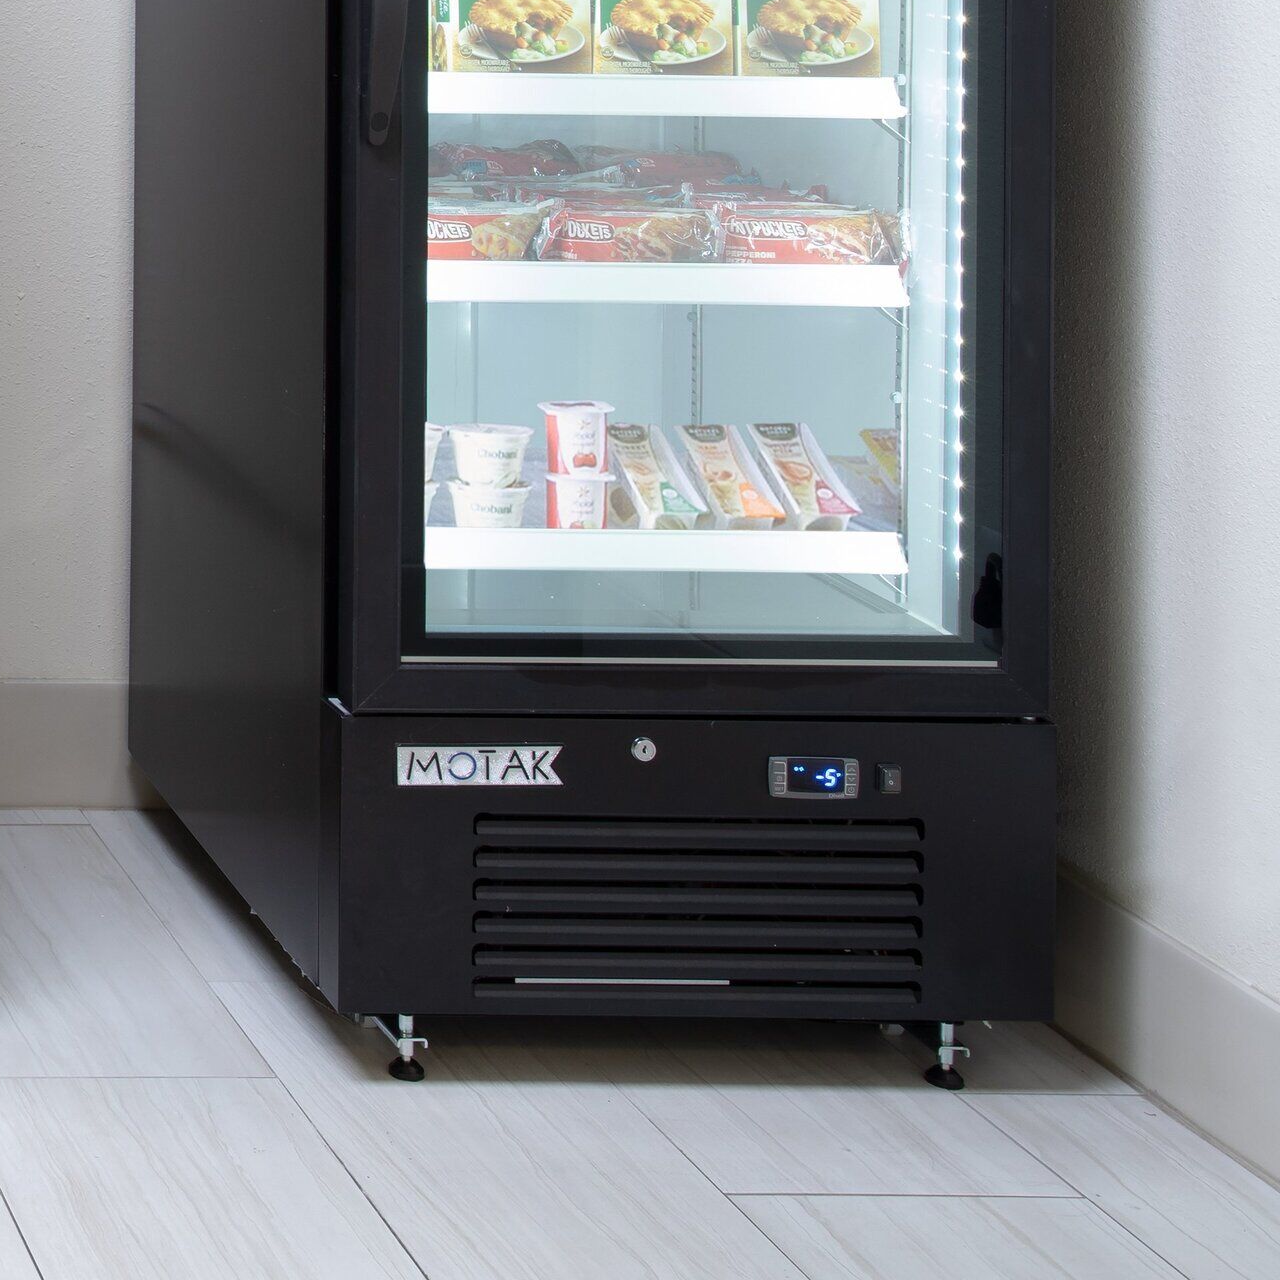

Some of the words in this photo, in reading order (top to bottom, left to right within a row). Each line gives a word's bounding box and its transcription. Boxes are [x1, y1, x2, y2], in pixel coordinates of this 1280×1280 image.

[752, 220, 807, 238] POCKETS
[470, 503, 513, 514] Chobani
[406, 749, 551, 781] MOTAK
